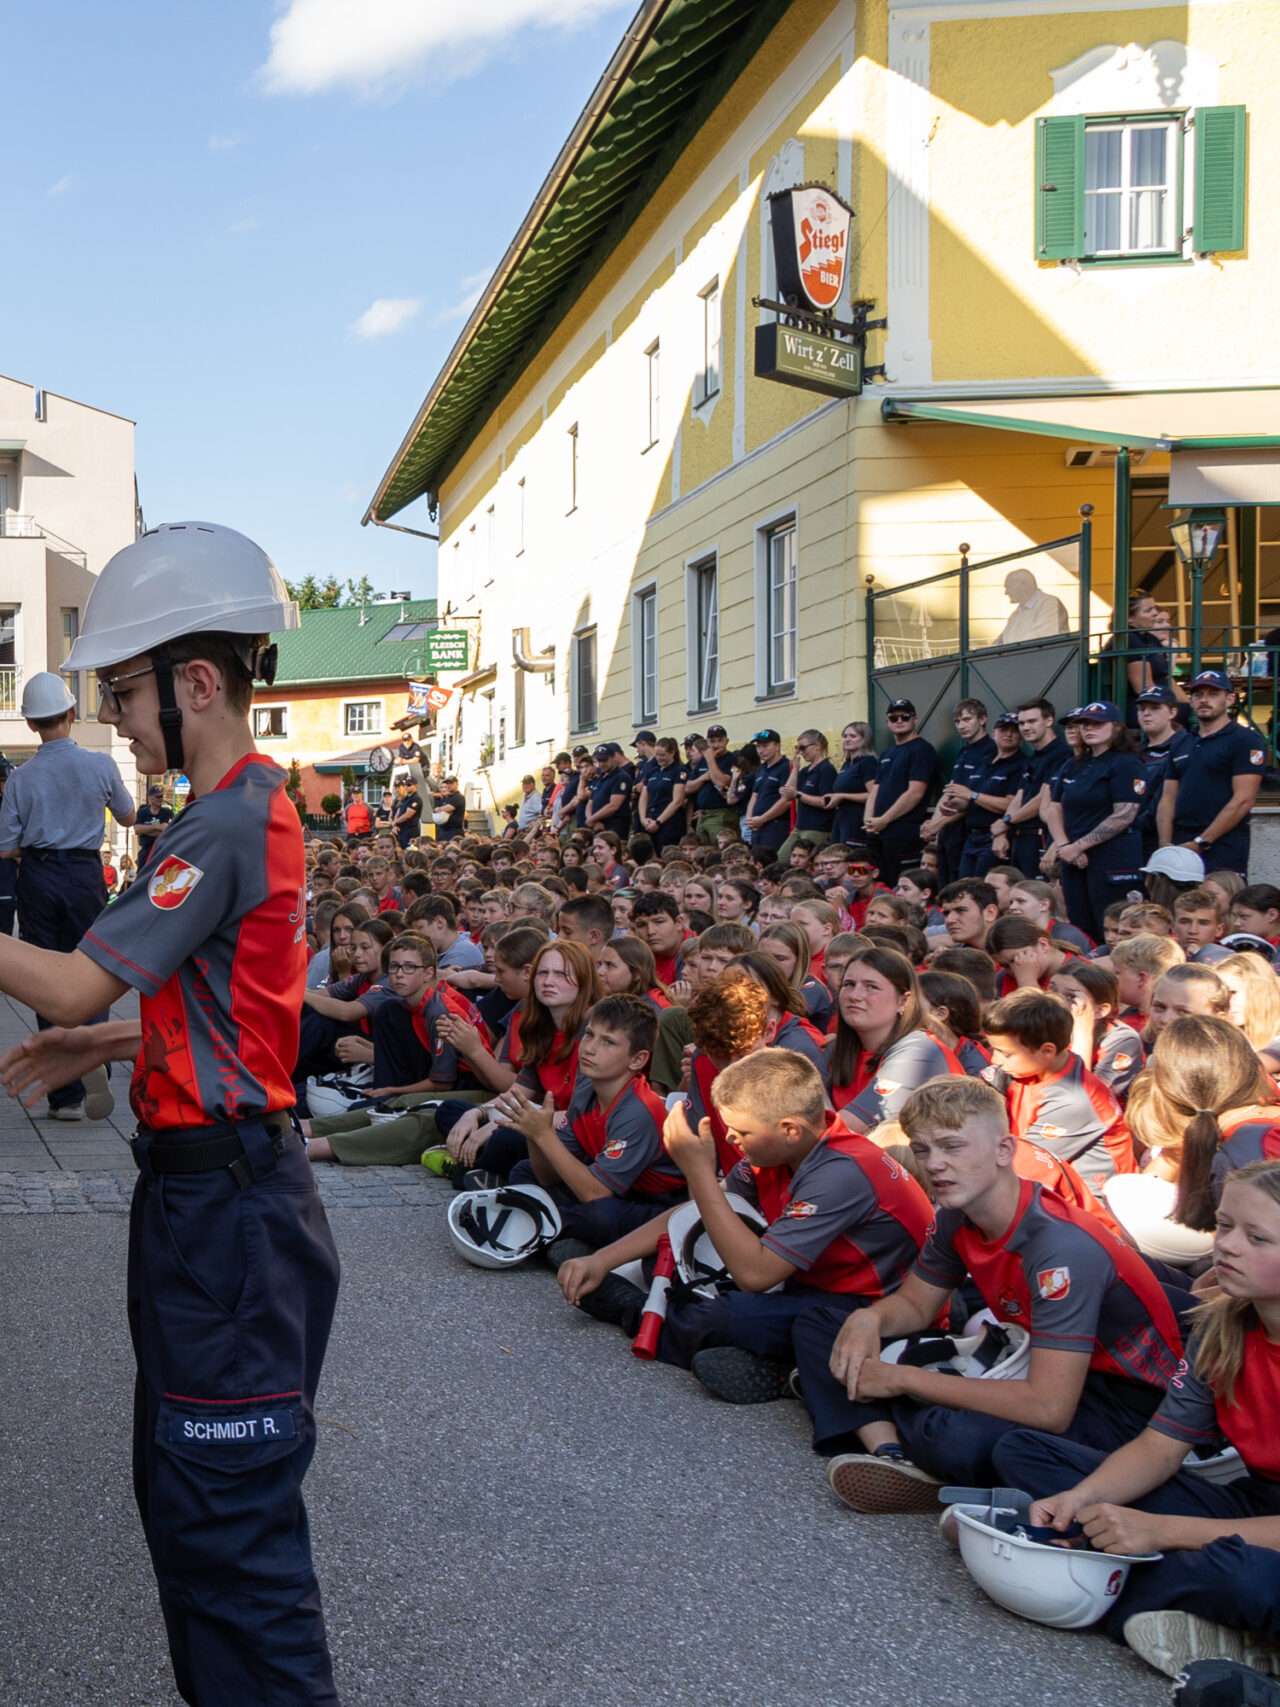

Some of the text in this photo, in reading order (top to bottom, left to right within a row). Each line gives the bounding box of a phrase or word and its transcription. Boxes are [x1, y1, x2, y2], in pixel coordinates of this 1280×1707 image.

[799, 217, 845, 264] Stiegl
[820, 271, 839, 288] BIER
[783, 334, 814, 361] Wirt
[830, 348, 854, 371] Zell
[430, 641, 466, 650] FLEISCH
[431, 650, 464, 660] BANK
[183, 1417, 280, 1440] SCHMIDT R.
